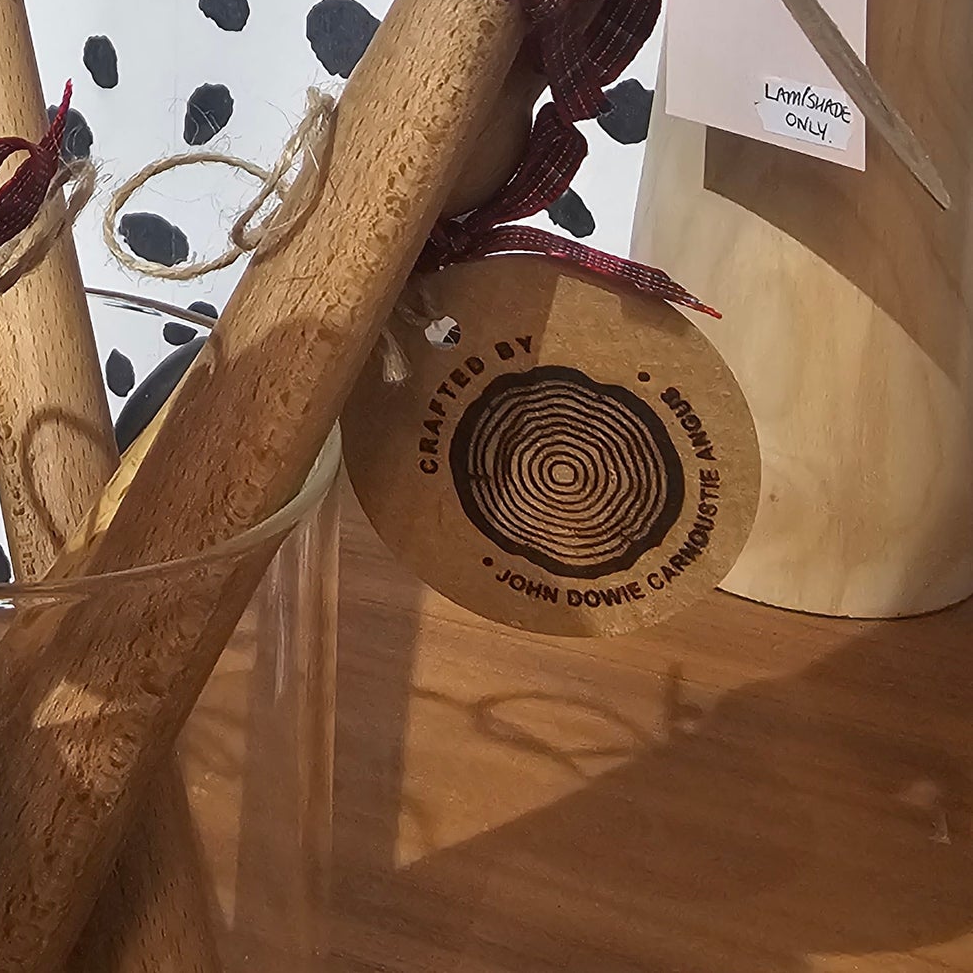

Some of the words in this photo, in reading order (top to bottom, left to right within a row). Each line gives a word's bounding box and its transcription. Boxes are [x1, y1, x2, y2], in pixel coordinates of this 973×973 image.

[419, 356, 485, 475] CRAFTED
[494, 335, 532, 361] BY
[660, 386, 717, 461] ANGUS
[646, 467, 722, 592] CARNOUSTIE
[495, 569, 559, 605] JOHN
[566, 581, 647, 609] DOWIE
